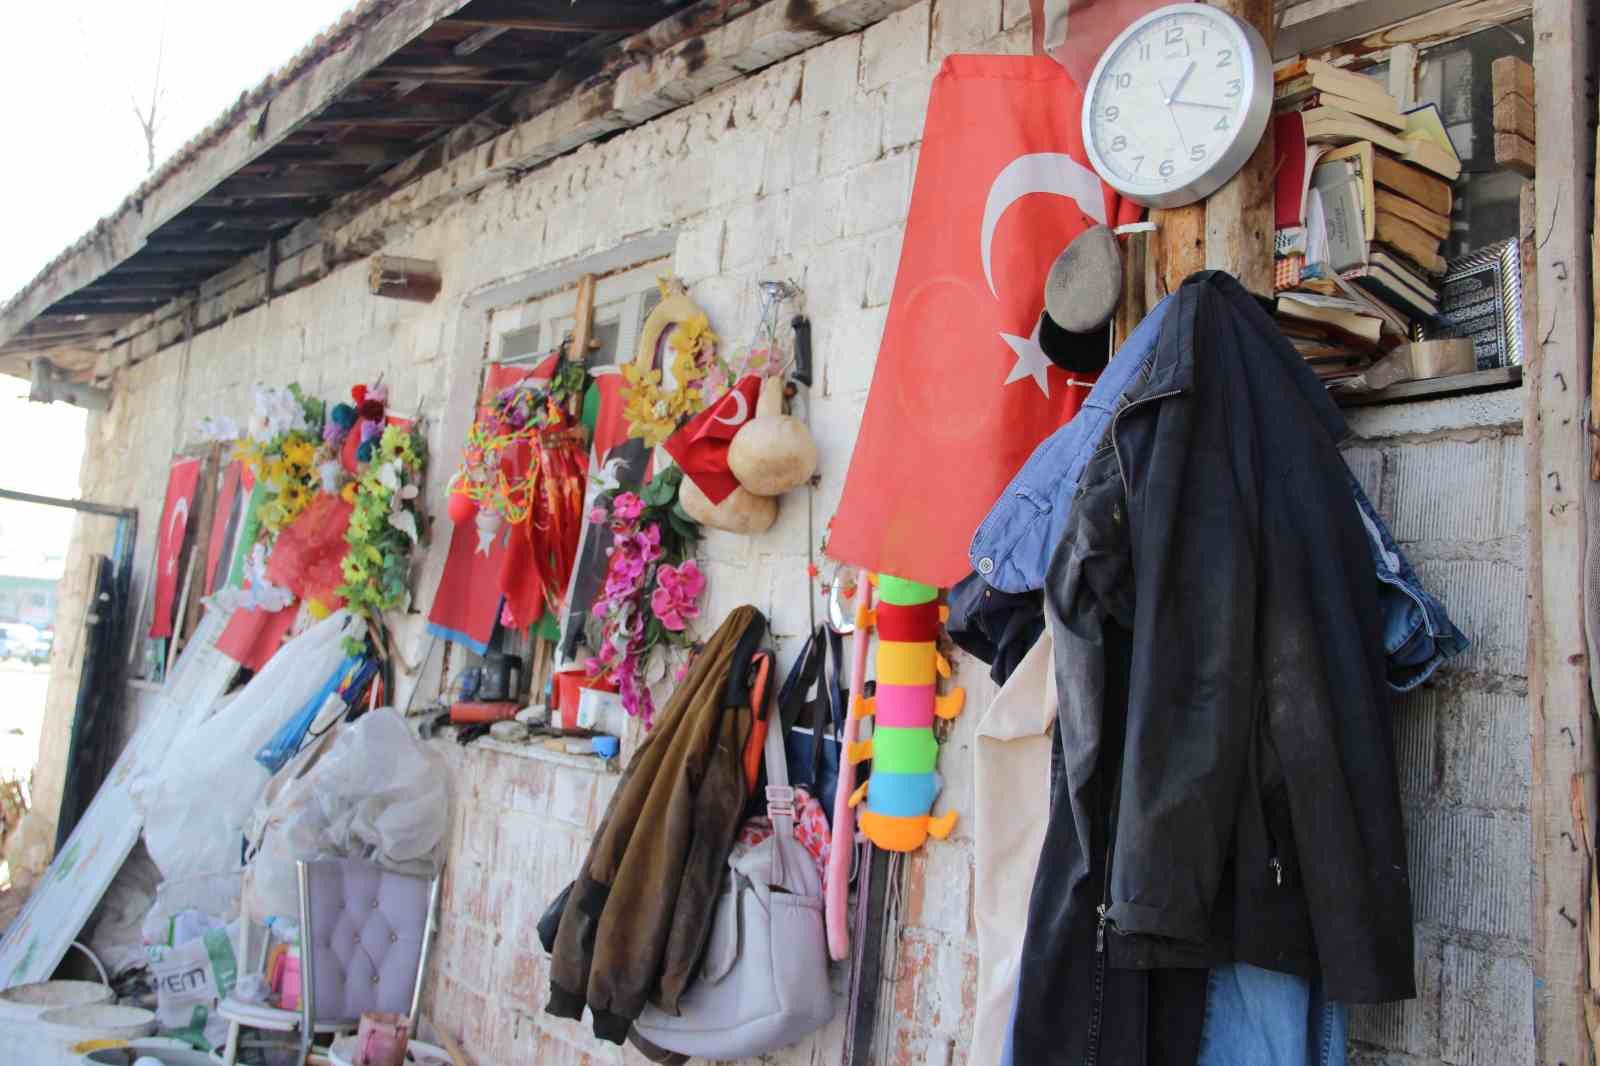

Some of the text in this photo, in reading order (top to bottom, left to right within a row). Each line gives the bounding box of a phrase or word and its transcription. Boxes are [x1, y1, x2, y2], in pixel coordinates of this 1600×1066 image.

[1165, 27, 1184, 46] 12
[1139, 44, 1150, 61] 11
[1216, 50, 1232, 68] 2
[1115, 72, 1132, 91] 10
[1224, 79, 1241, 97] 3
[1104, 106, 1120, 122] 9
[1213, 116, 1230, 131] 4
[1111, 136, 1128, 152] 8
[1190, 145, 1206, 161] 5
[1131, 156, 1145, 173] 7
[1159, 160, 1175, 177] 6
